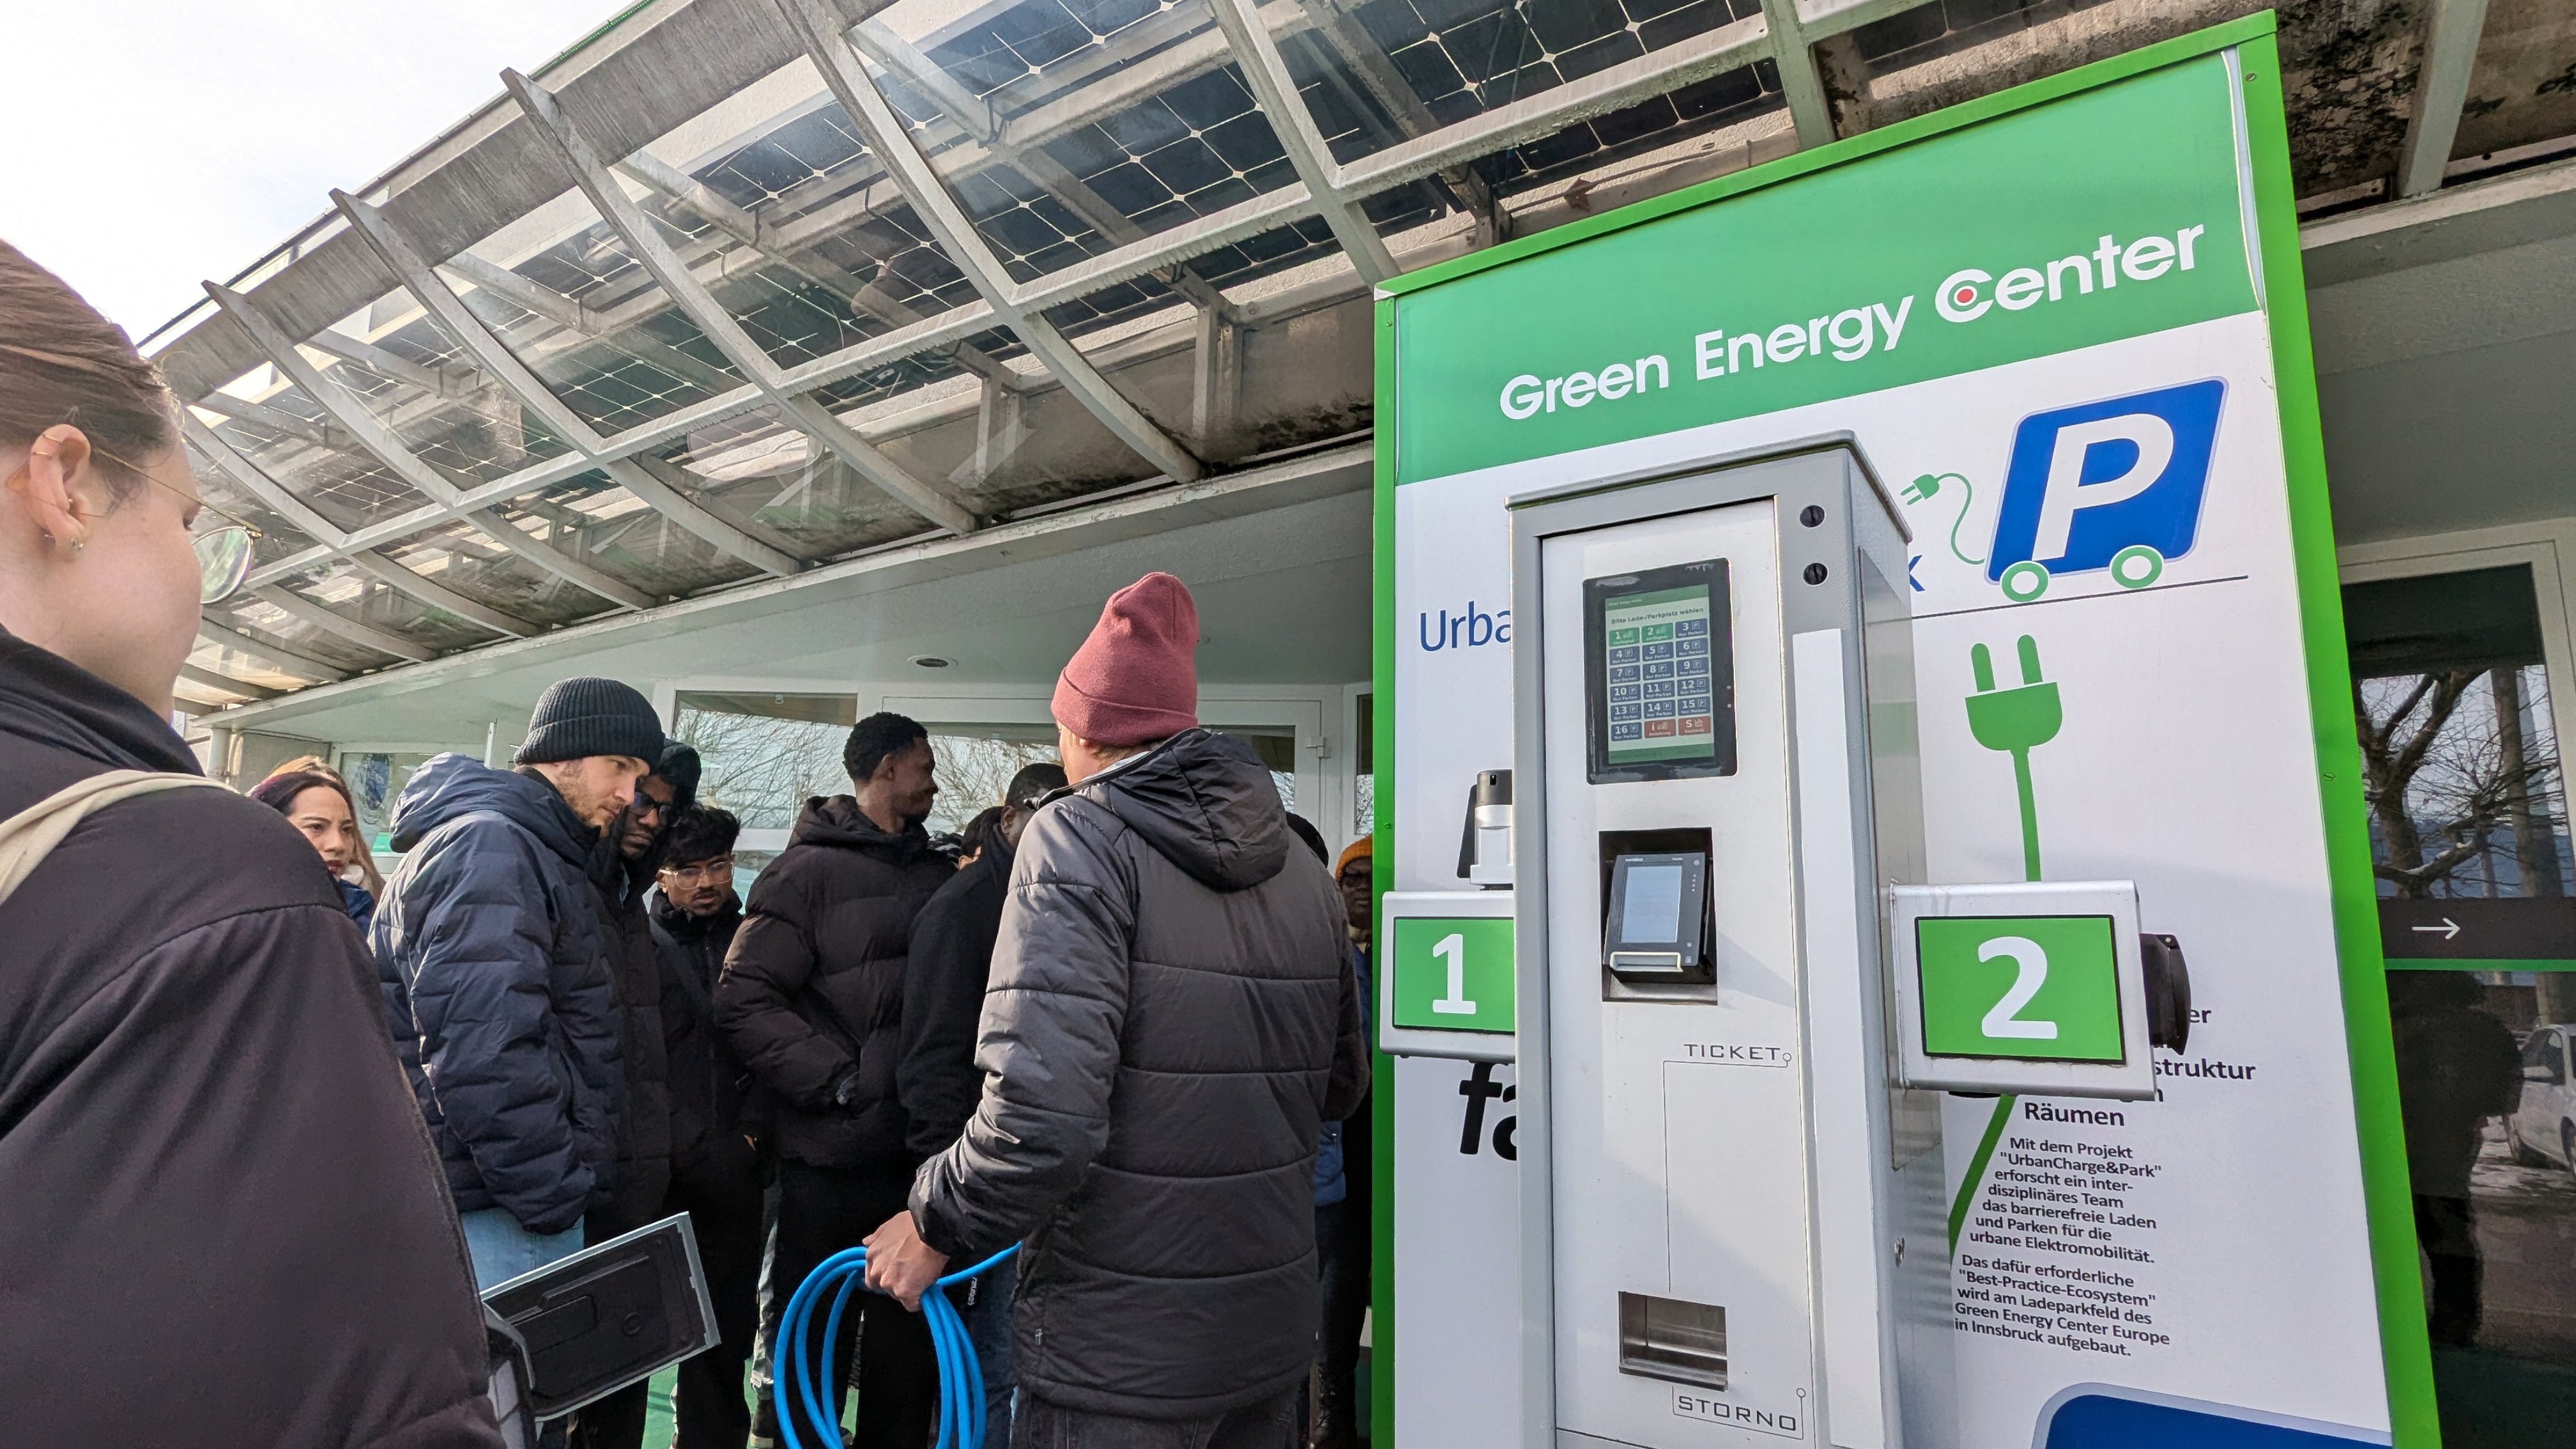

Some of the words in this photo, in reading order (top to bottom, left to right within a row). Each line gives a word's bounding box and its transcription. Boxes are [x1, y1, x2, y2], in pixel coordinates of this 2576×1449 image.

[1500, 355, 1668, 419] Green
[1696, 295, 1914, 380] Energy
[1935, 224, 2204, 323] Center
[2032, 413, 2174, 561] P
[1649, 646, 1655, 654] 5
[1614, 687, 1627, 696] 10
[1647, 684, 1660, 693] 11
[1682, 680, 1694, 689] 12
[1615, 707, 1627, 715] 13
[1648, 703, 1660, 711] 14
[1682, 700, 1695, 709] 15
[1615, 726, 1628, 734] 16
[1433, 934, 1476, 1014] 1
[1979, 937, 2057, 1039] 2
[1683, 1043, 1781, 1061] TICKET
[2025, 1103, 2124, 1126] Räumen
[2010, 1137, 2035, 1150] Mit
[2040, 1140, 2073, 1153] dem
[2078, 1143, 2133, 1159] Projekt
[2001, 1152, 2161, 1177] "UrbanCharge&Park"
[1995, 1169, 2060, 1185] erforscht
[2064, 1175, 2087, 1188] ein
[2091, 1177, 2133, 1192] inter-
[1988, 1184, 2078, 1203] disziplinäres
[2081, 1193, 2124, 1208] Team
[1982, 1199, 2007, 1213] das
[2011, 1201, 2104, 1223] barrierefreie
[2110, 1213, 2156, 1229] Laden
[1975, 1216, 2003, 1229] und
[2007, 1218, 2057, 1234] Parken
[2062, 1224, 2084, 1237] für
[2089, 1227, 2112, 1241] die
[1970, 1231, 2021, 1246] urbane
[2025, 1237, 2154, 1263] Elektromobilität.
[1963, 1255, 1988, 1268] Das
[1992, 1259, 2031, 1273] dafür
[2035, 1265, 2134, 1287] erforderliche
[1959, 1269, 2156, 1307] "Best-Practice-Ecosystem"
[1958, 1287, 1989, 1301] wird
[1994, 1294, 2016, 1305] am
[2021, 1294, 2119, 1320] Ladeparkfeld
[2124, 1310, 2152, 1324] des
[1956, 1303, 1998, 1319] Green
[2003, 1309, 2053, 1330] Energy
[2057, 1317, 2108, 1335] Center
[2113, 1325, 2170, 1346] Europe
[1955, 1319, 1968, 1331] in
[1972, 1321, 2043, 1342] Innsbruck
[2048, 1335, 2131, 1356] aufgebaut.
[1678, 1395, 1796, 1431] STORNO
